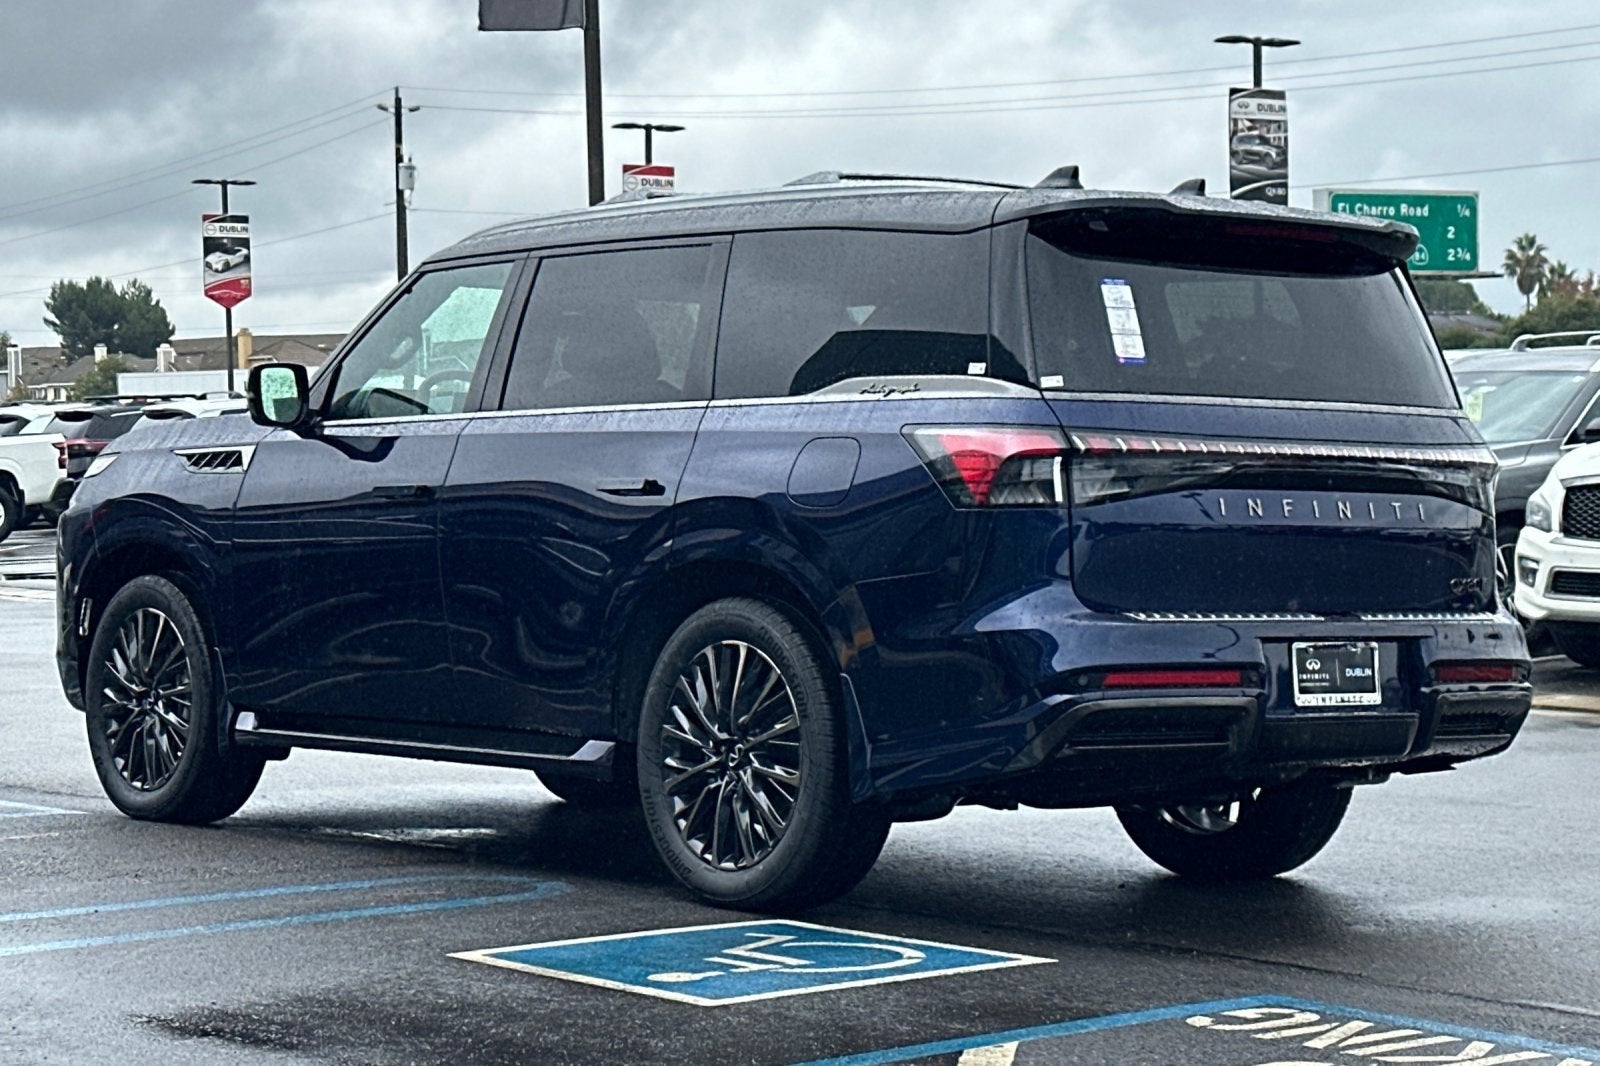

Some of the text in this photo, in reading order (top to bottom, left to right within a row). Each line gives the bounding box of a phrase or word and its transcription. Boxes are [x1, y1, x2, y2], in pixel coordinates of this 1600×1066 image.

[1257, 103, 1286, 113] DUBLIN
[641, 177, 674, 188] DUBLIN
[1354, 203, 1396, 217] Charro
[1400, 203, 1430, 217] Road
[219, 225, 249, 233] DUBLIN
[1446, 226, 1456, 239] 2
[1218, 497, 1426, 521] INFINITI
[1345, 667, 1373, 678] DUBLIN
